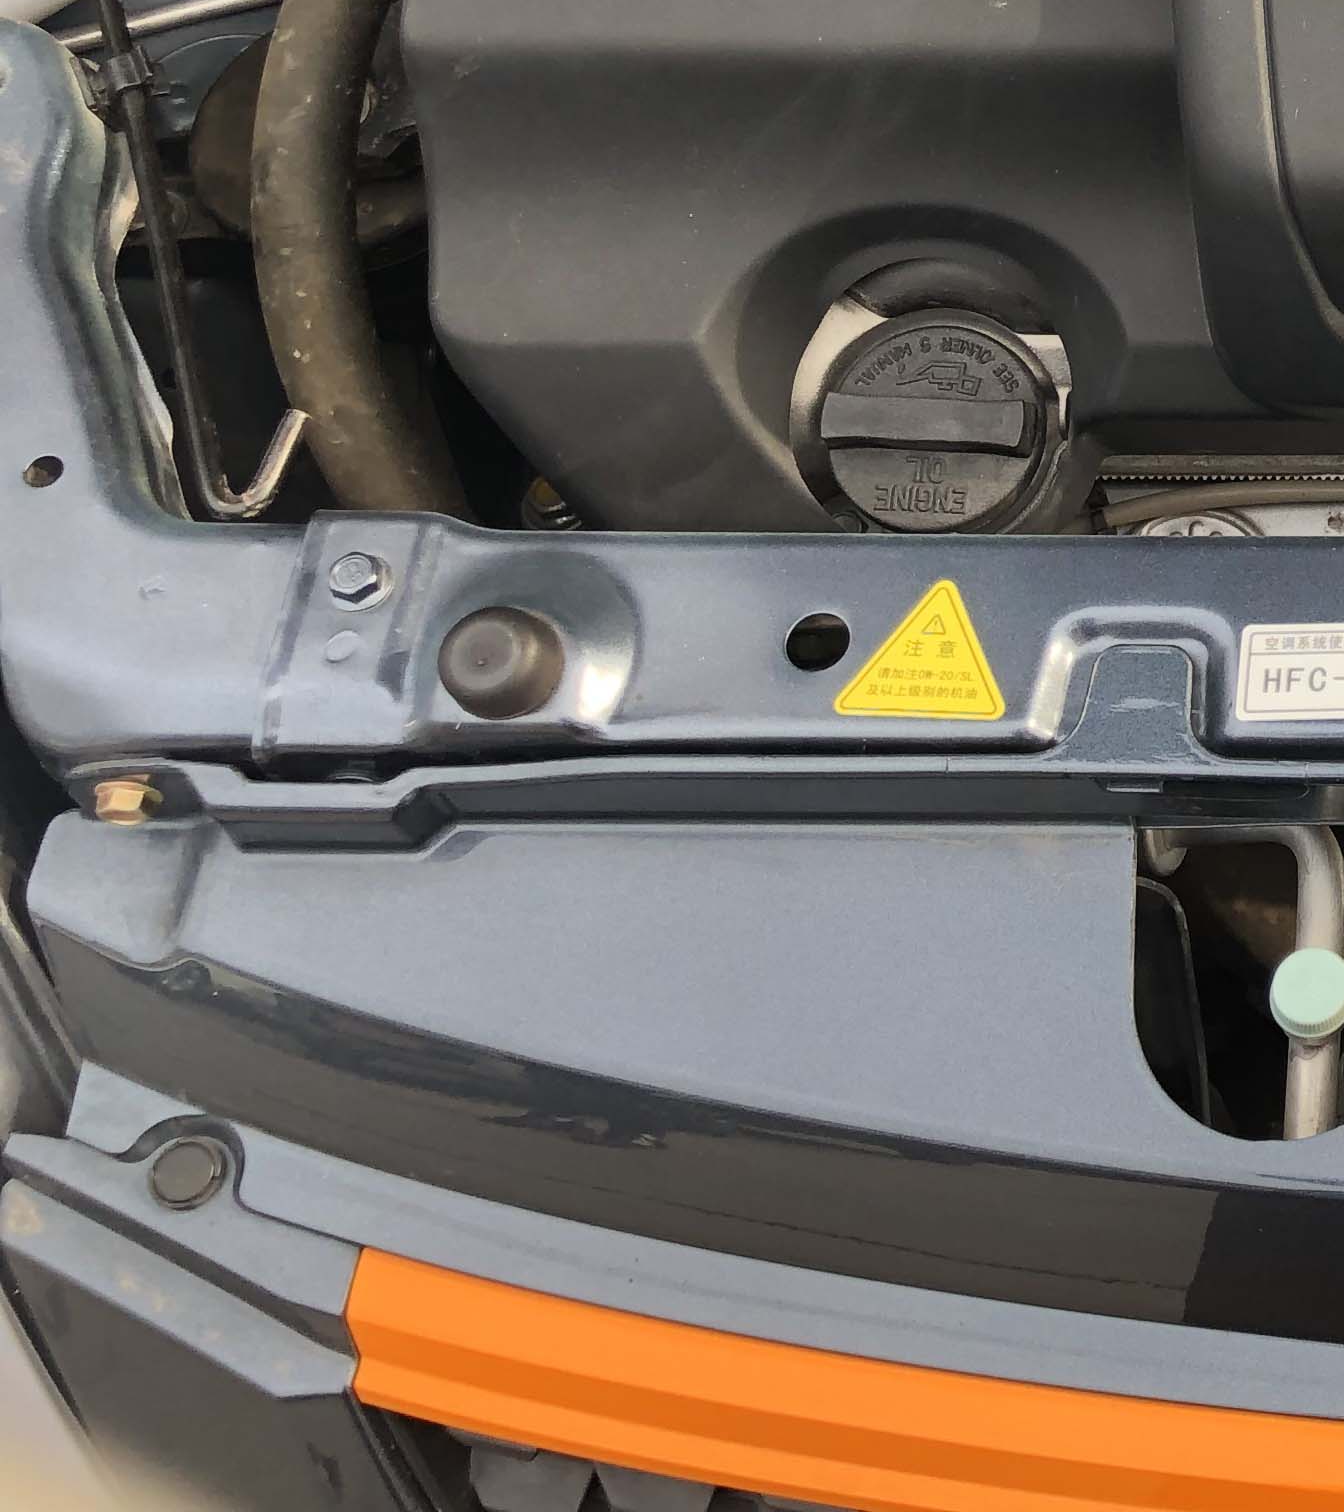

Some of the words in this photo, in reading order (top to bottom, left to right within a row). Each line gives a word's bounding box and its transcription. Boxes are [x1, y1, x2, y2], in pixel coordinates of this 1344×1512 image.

[853, 341, 912, 389] MANUAL
[992, 362, 1020, 394] SEE
[905, 455, 947, 484] OIL
[872, 484, 967, 515] ENGINE
[903, 638, 956, 658] 注意
[866, 683, 978, 700] 及以上级别的机油
